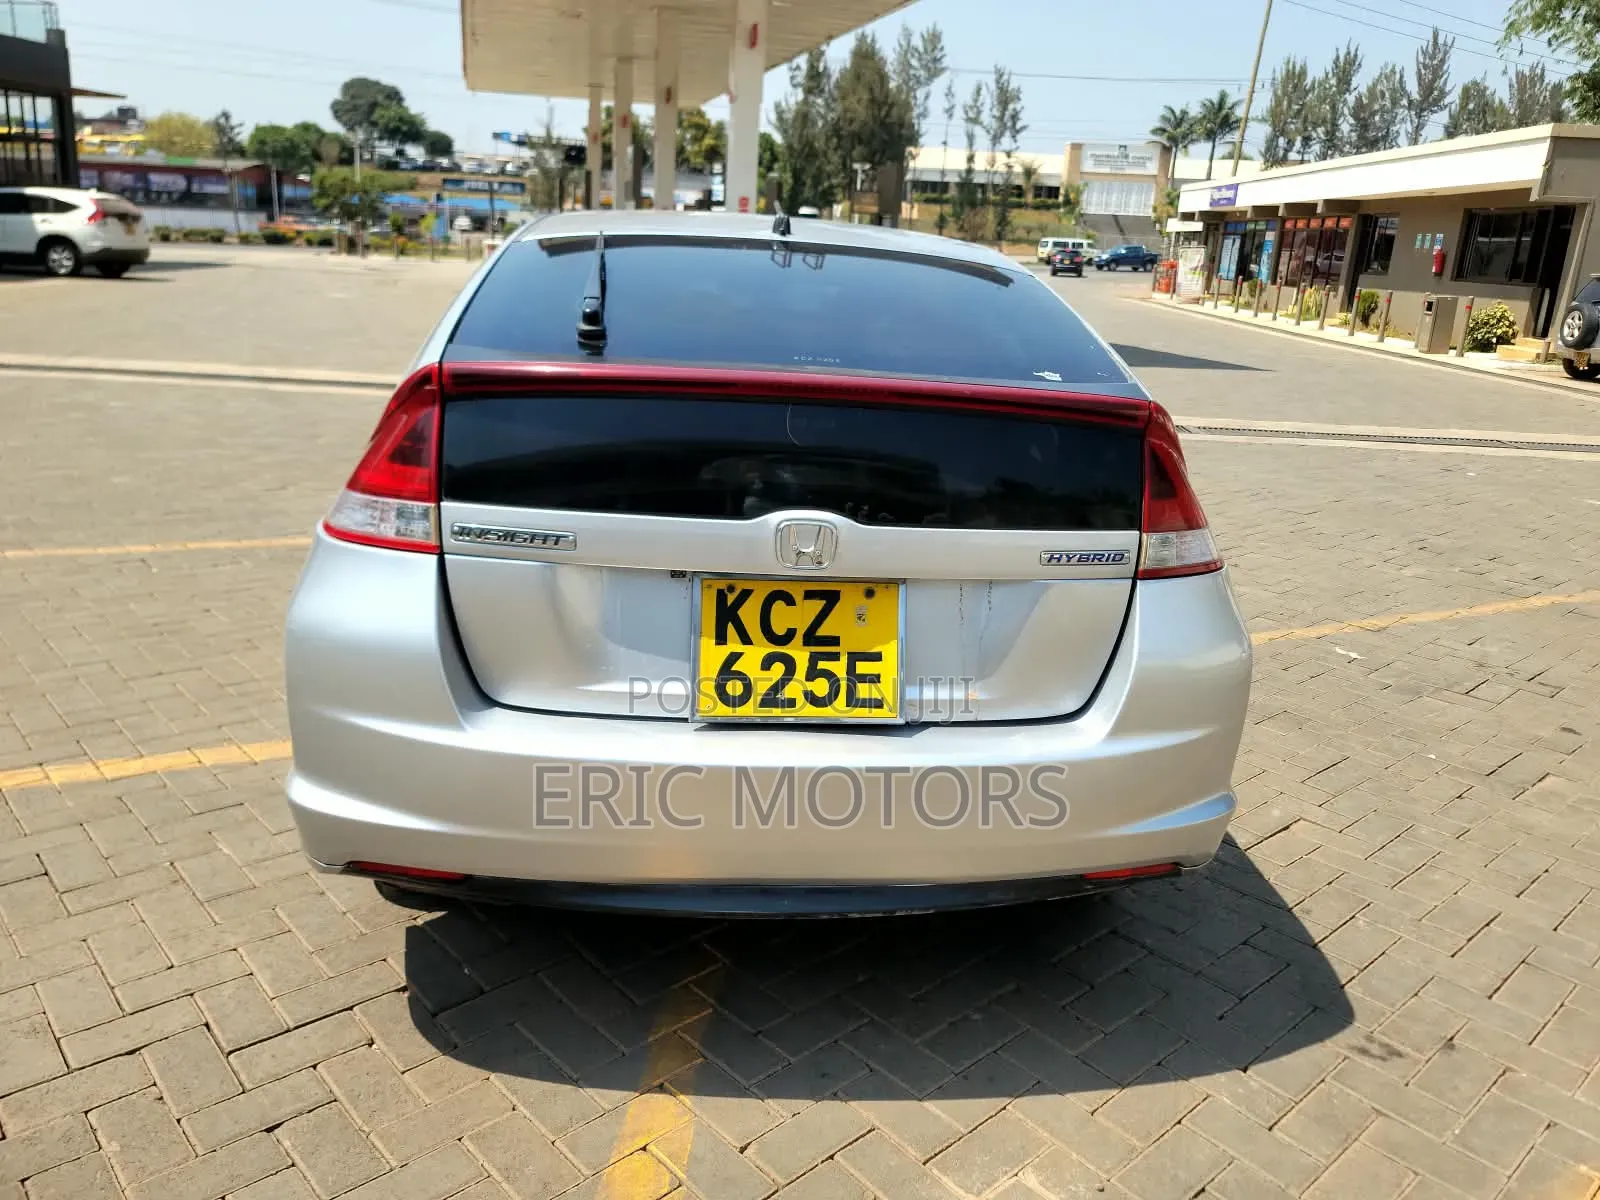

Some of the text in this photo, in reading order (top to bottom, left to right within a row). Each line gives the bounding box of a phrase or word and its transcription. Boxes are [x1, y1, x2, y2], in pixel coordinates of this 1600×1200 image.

[455, 525, 569, 546] INSIGHT
[1046, 553, 1125, 563] HYBRID
[714, 588, 841, 647] KCZ
[714, 651, 884, 708] 625E
